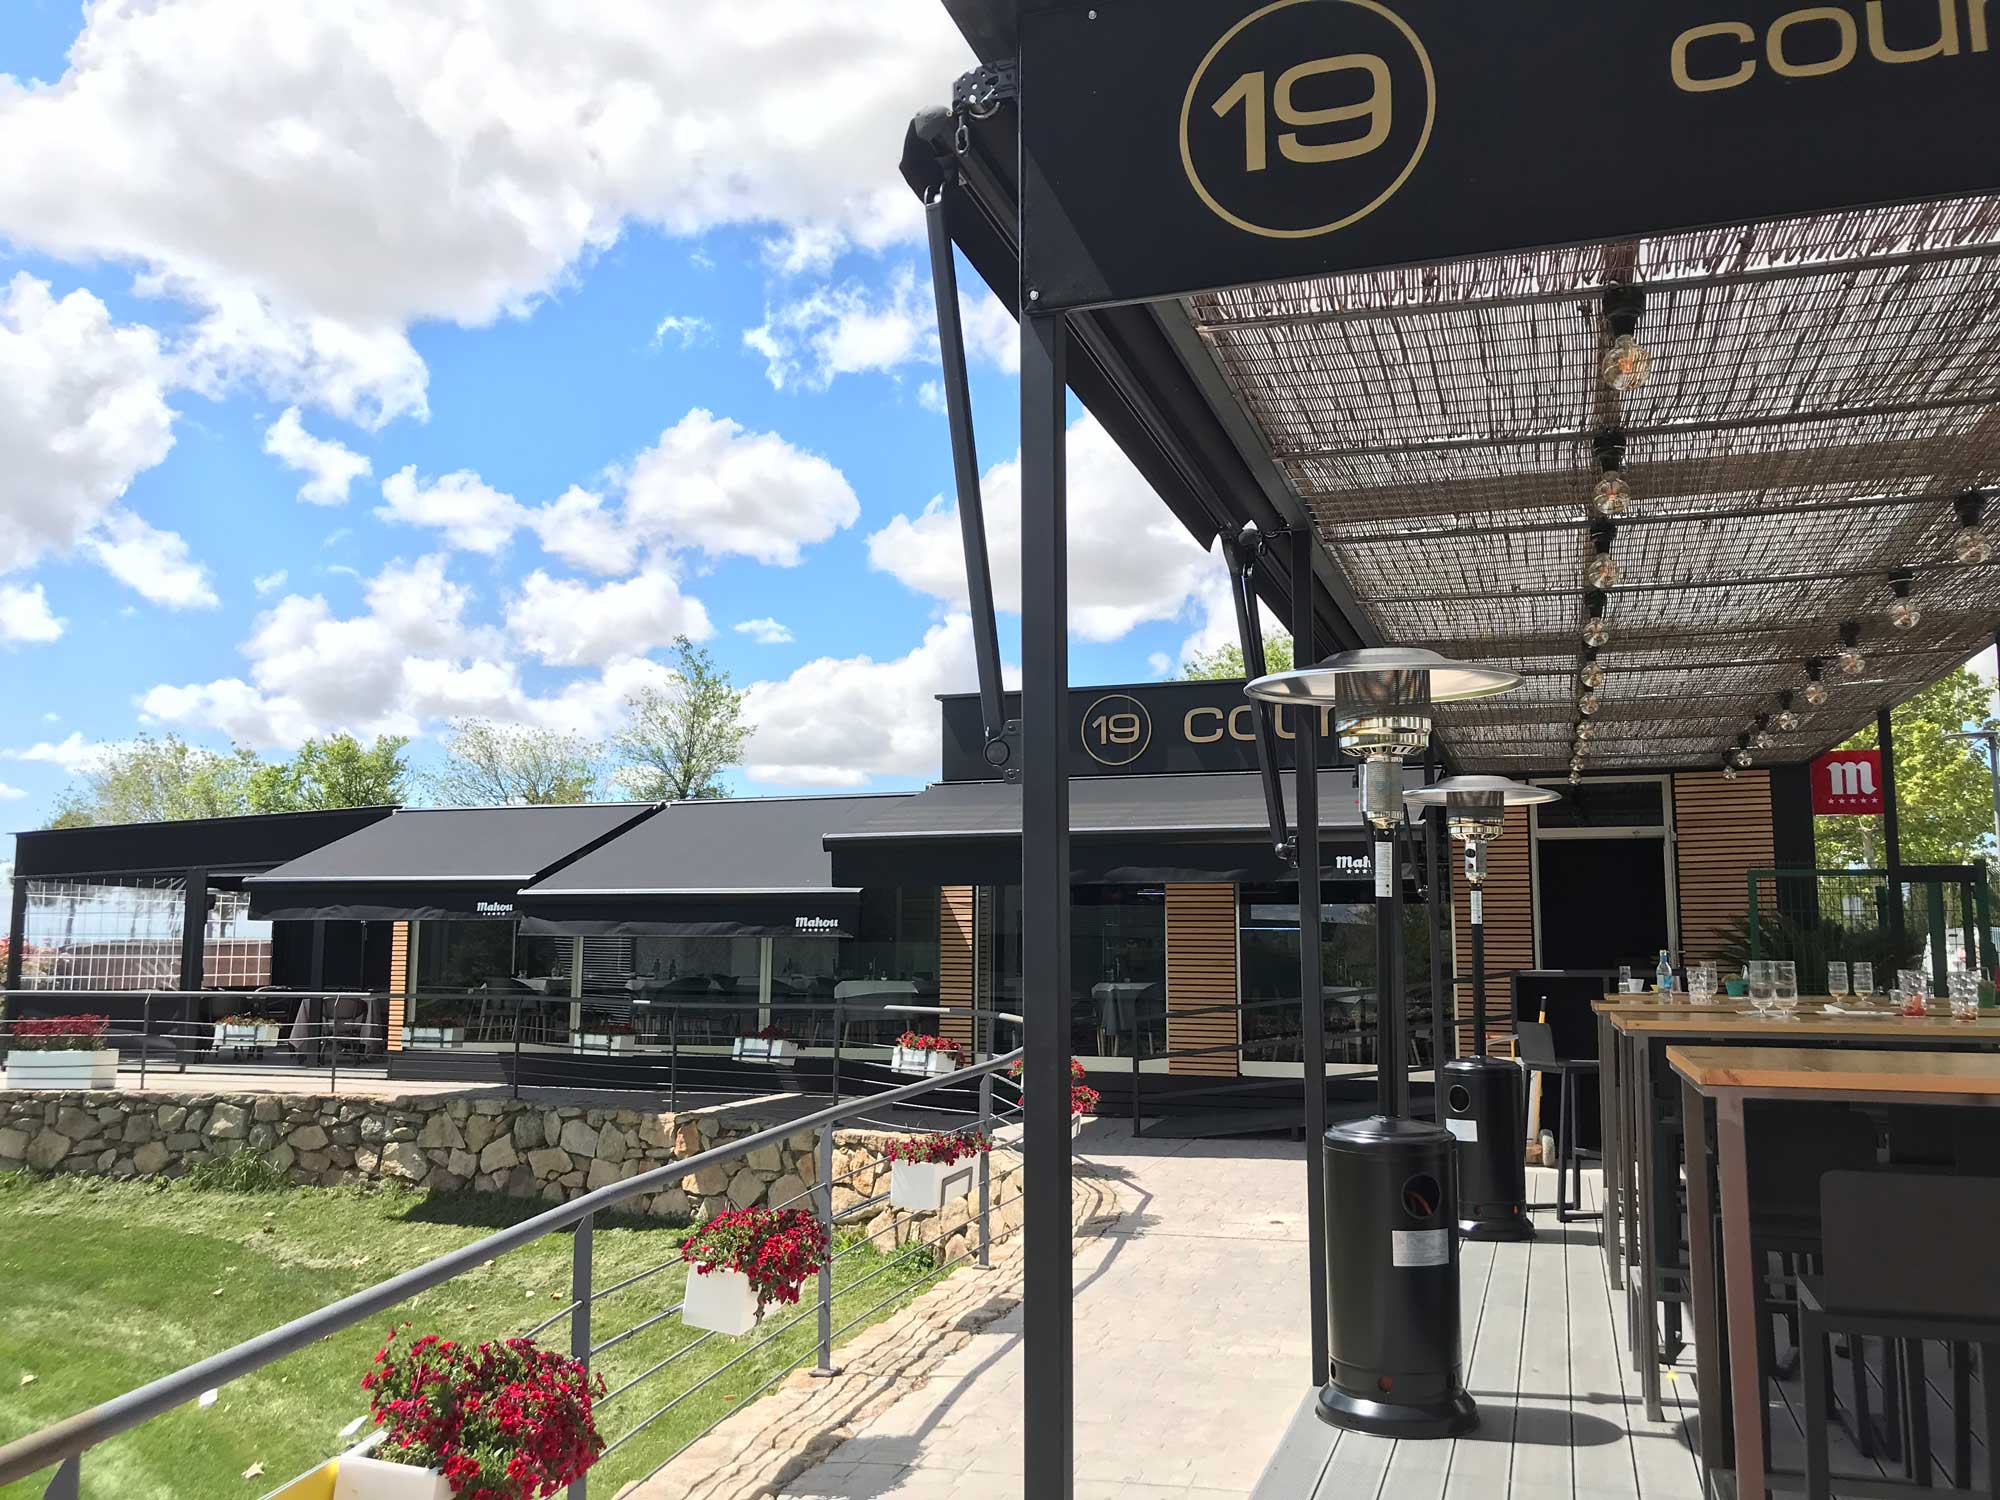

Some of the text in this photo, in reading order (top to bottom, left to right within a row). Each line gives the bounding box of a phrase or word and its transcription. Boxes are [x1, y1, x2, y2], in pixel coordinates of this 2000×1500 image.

[1211, 53, 1392, 172] 19
[1092, 713, 1140, 745] 19
[1335, 855, 1371, 869] Mah
[476, 901, 513, 912] Mahou
[795, 916, 839, 928] Mahou
